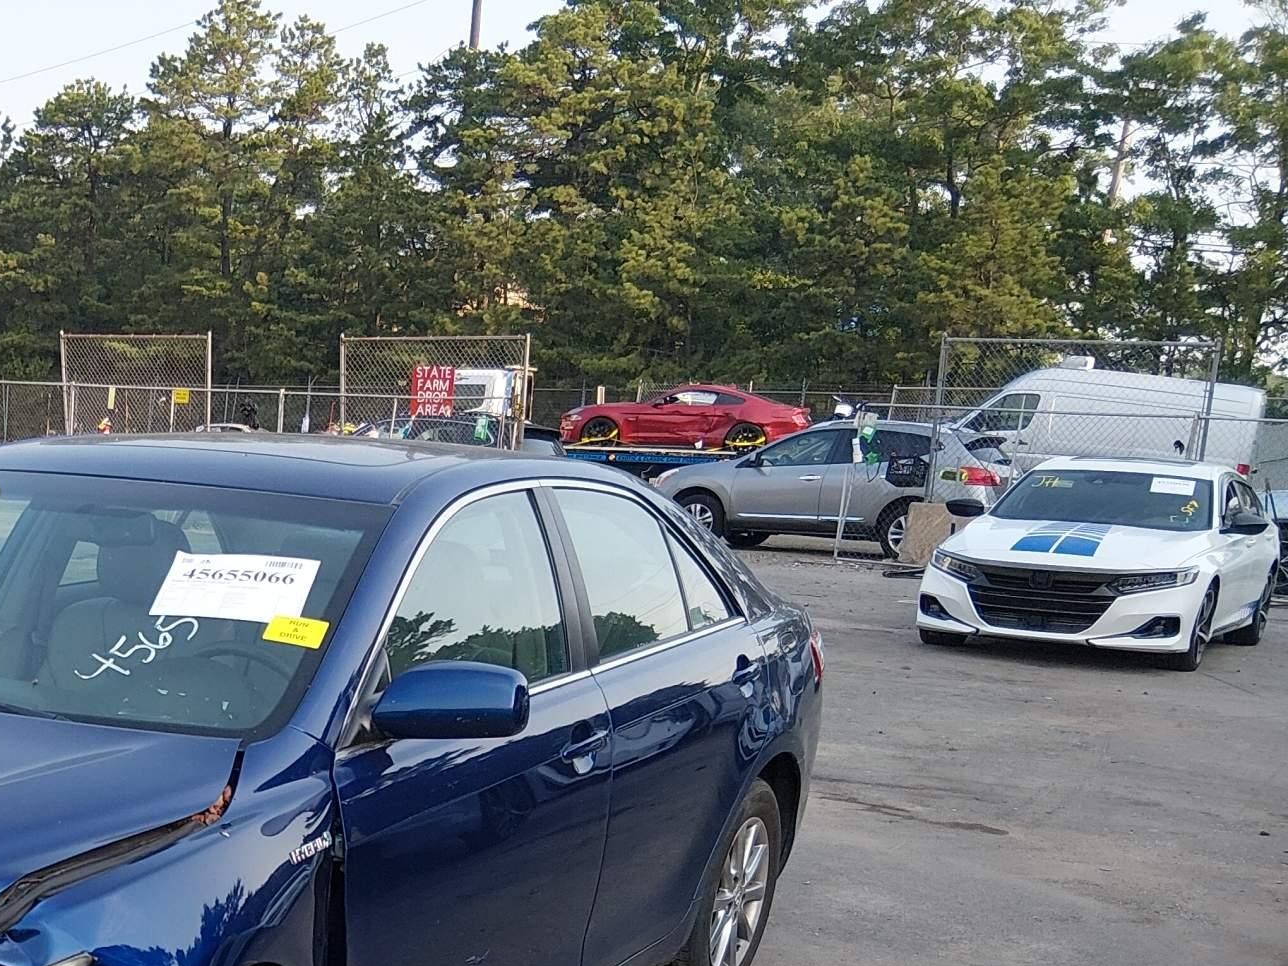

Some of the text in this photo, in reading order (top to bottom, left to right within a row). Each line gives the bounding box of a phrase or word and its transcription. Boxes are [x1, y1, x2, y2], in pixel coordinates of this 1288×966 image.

[416, 366, 452, 378] STATE
[417, 379, 450, 391] FARM
[417, 391, 448, 403] DROP
[415, 404, 446, 416] AREA
[183, 568, 297, 585] 45655066
[279, 631, 309, 641] DRIVE
